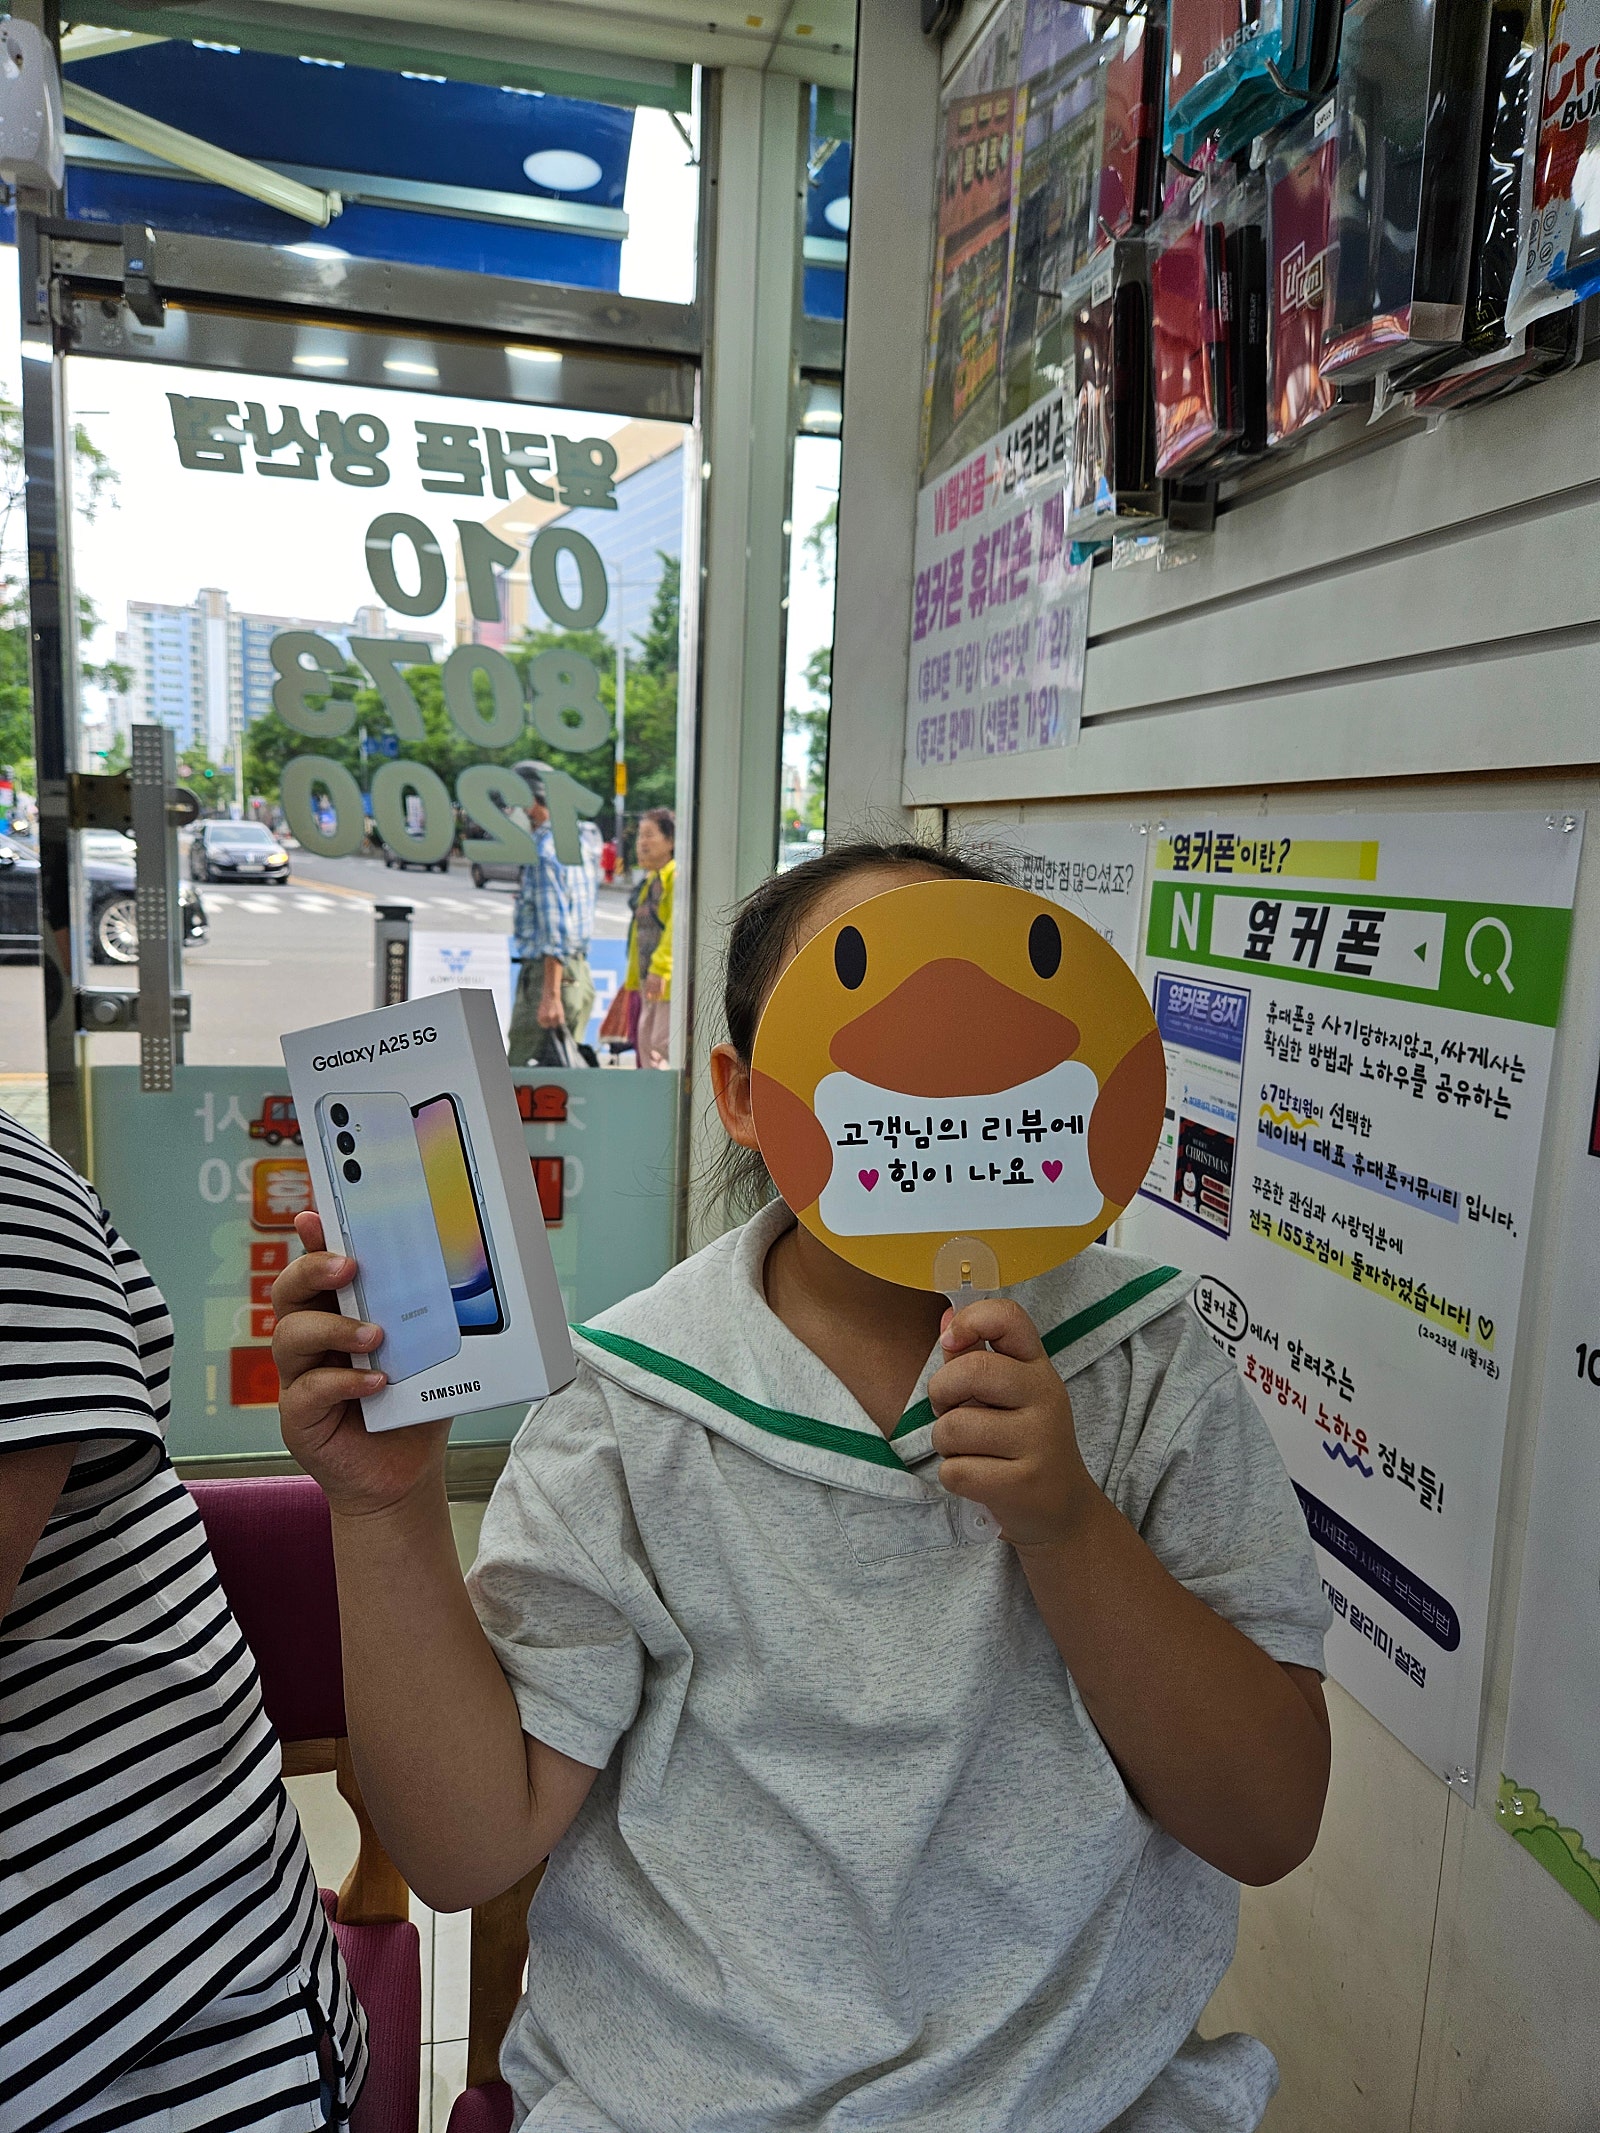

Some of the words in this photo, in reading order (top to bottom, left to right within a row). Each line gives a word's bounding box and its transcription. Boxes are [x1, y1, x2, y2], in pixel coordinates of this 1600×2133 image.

[913, 546, 966, 641] 옆커폰
[968, 505, 1033, 620] 휴대폰
[1072, 863, 1134, 895] 많으셨죠?
[1210, 994, 1242, 1030] 성지
[1265, 1001, 1316, 1035] 휴대폰을
[312, 1043, 376, 1073] Galaxy
[378, 1031, 411, 1055] A25
[411, 1026, 438, 1046] 5G
[1263, 1028, 1303, 1063] 확실한
[1308, 1039, 1354, 1076] 방법과
[1359, 1055, 1428, 1099] 노하우를
[1434, 1075, 1512, 1120] 공유하는
[836, 1115, 968, 1150] 고객님의
[982, 1109, 1085, 1144] 리뷰에
[1260, 1084, 1324, 1120] 67만회원이
[1329, 1102, 1373, 1138] 선택한
[887, 1157, 952, 1193] 힘이
[969, 1157, 1035, 1185] 나요
[1185, 1144, 1229, 1175] CHRISTMAS
[1257, 1118, 1308, 1153] 네이버
[1313, 1137, 1347, 1170] 대표
[1351, 1151, 1459, 1210] 휴대폰커뮤니티
[1465, 1195, 1520, 1238] 입니다.
[1251, 1174, 1285, 1206] 꾸준한
[1288, 1189, 1327, 1225] 관심과
[1331, 1206, 1404, 1256] 사랑덕분에
[1249, 1209, 1273, 1237] 전국
[1277, 1218, 1345, 1269] 155호점이
[1351, 1251, 1472, 1332] 돌파하였습니다!
[400, 1305, 429, 1323] SAMSUNG
[1201, 1287, 1239, 1332] 옆커폰
[1250, 1321, 1279, 1351] 에서
[1287, 1339, 1356, 1403] 알려주는
[1418, 1323, 1458, 1356] (2023년
[420, 1379, 482, 1403] SAMSUNG
[1243, 1354, 1308, 1416] 호갱방지
[1314, 1400, 1370, 1456] 노하우
[1377, 1441, 1444, 1514] 정보들!
[1350, 1603, 1394, 1660] 알리미
[1394, 1645, 1426, 1688] 설정
